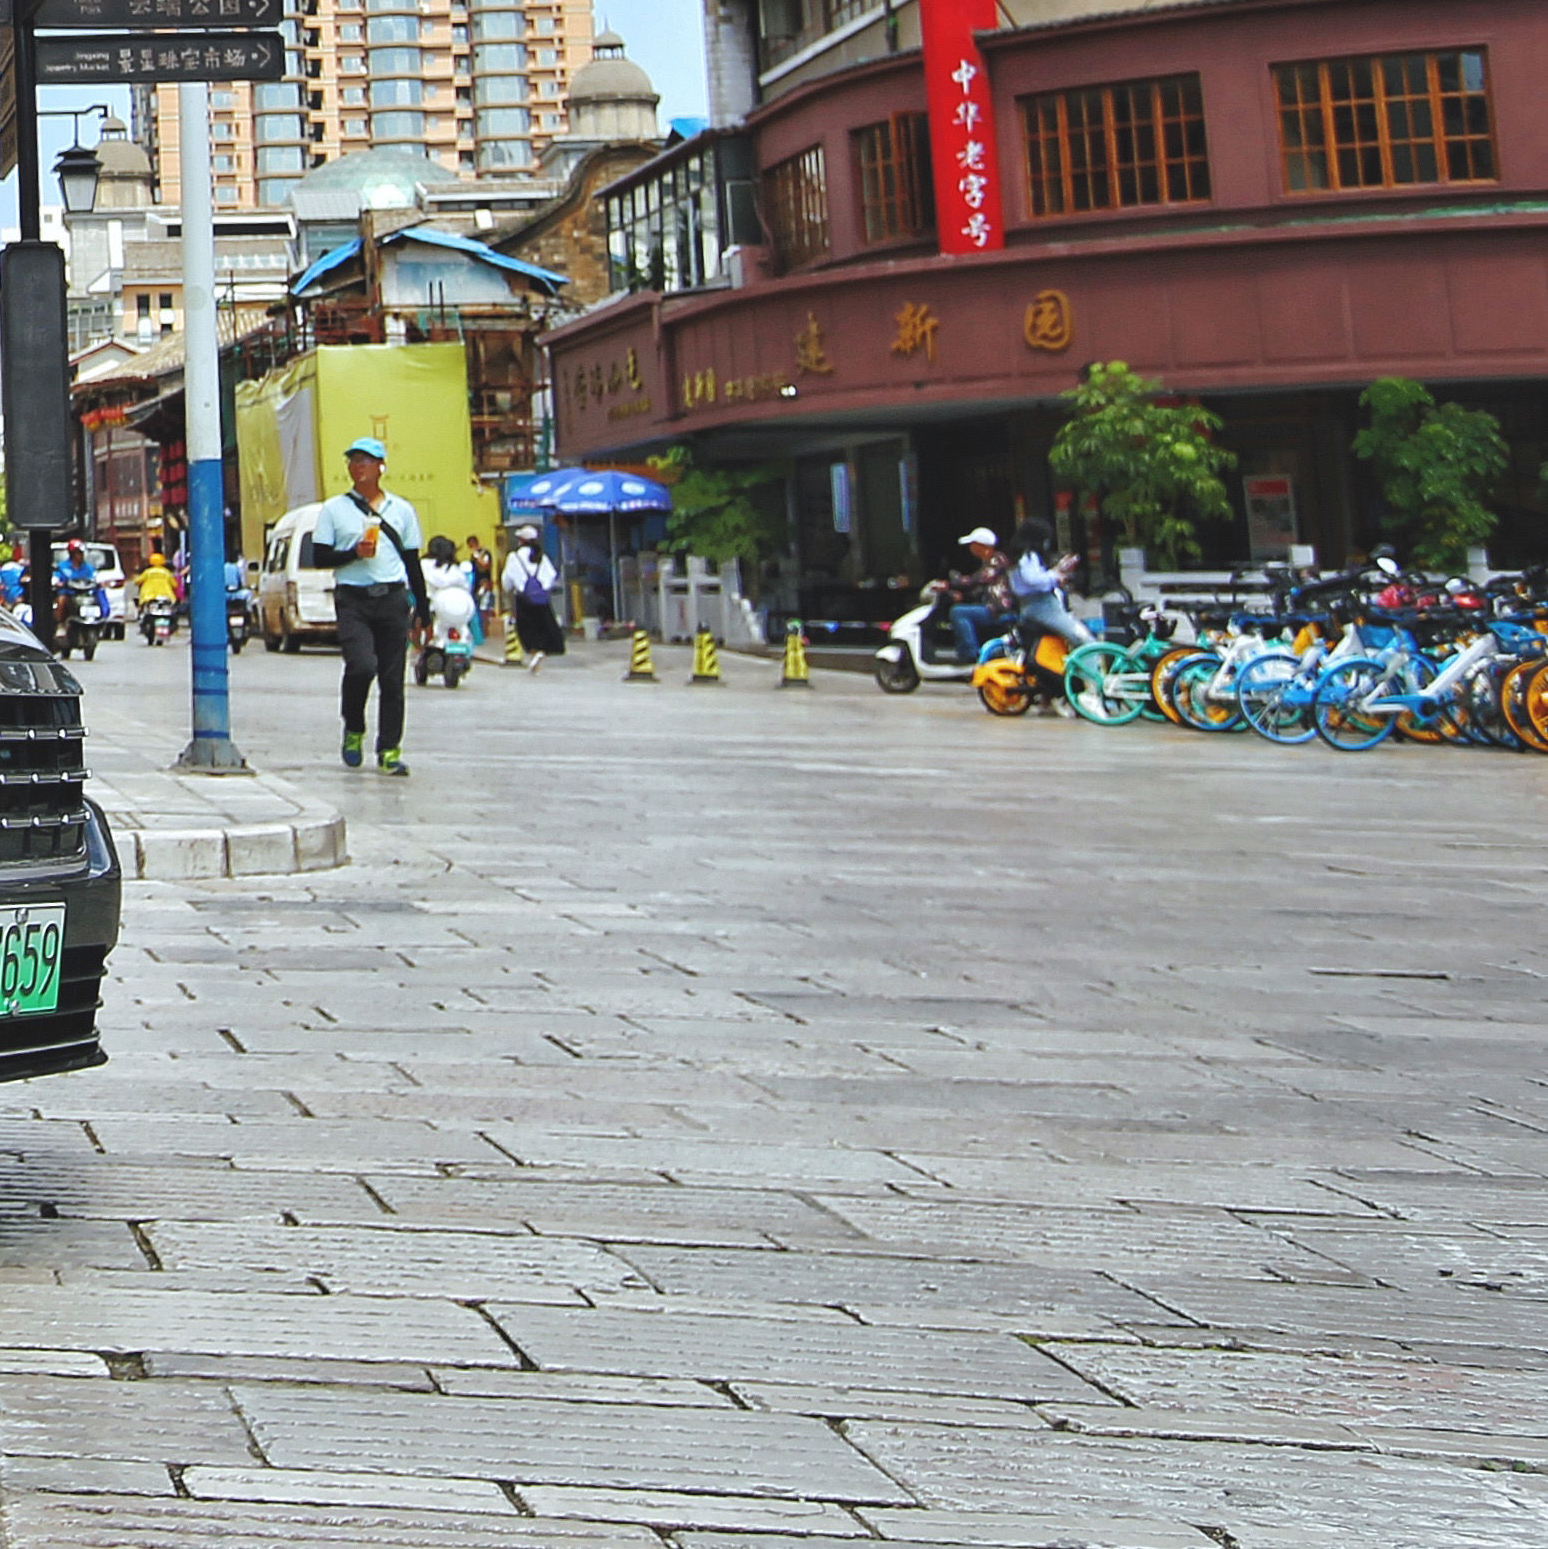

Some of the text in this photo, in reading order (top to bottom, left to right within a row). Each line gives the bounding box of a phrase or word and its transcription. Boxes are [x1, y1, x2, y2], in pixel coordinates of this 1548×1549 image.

[79, 62, 110, 71] Market
[117, 46, 246, 74] 景星珠宝市场
[951, 58, 992, 248] 中华老字号
